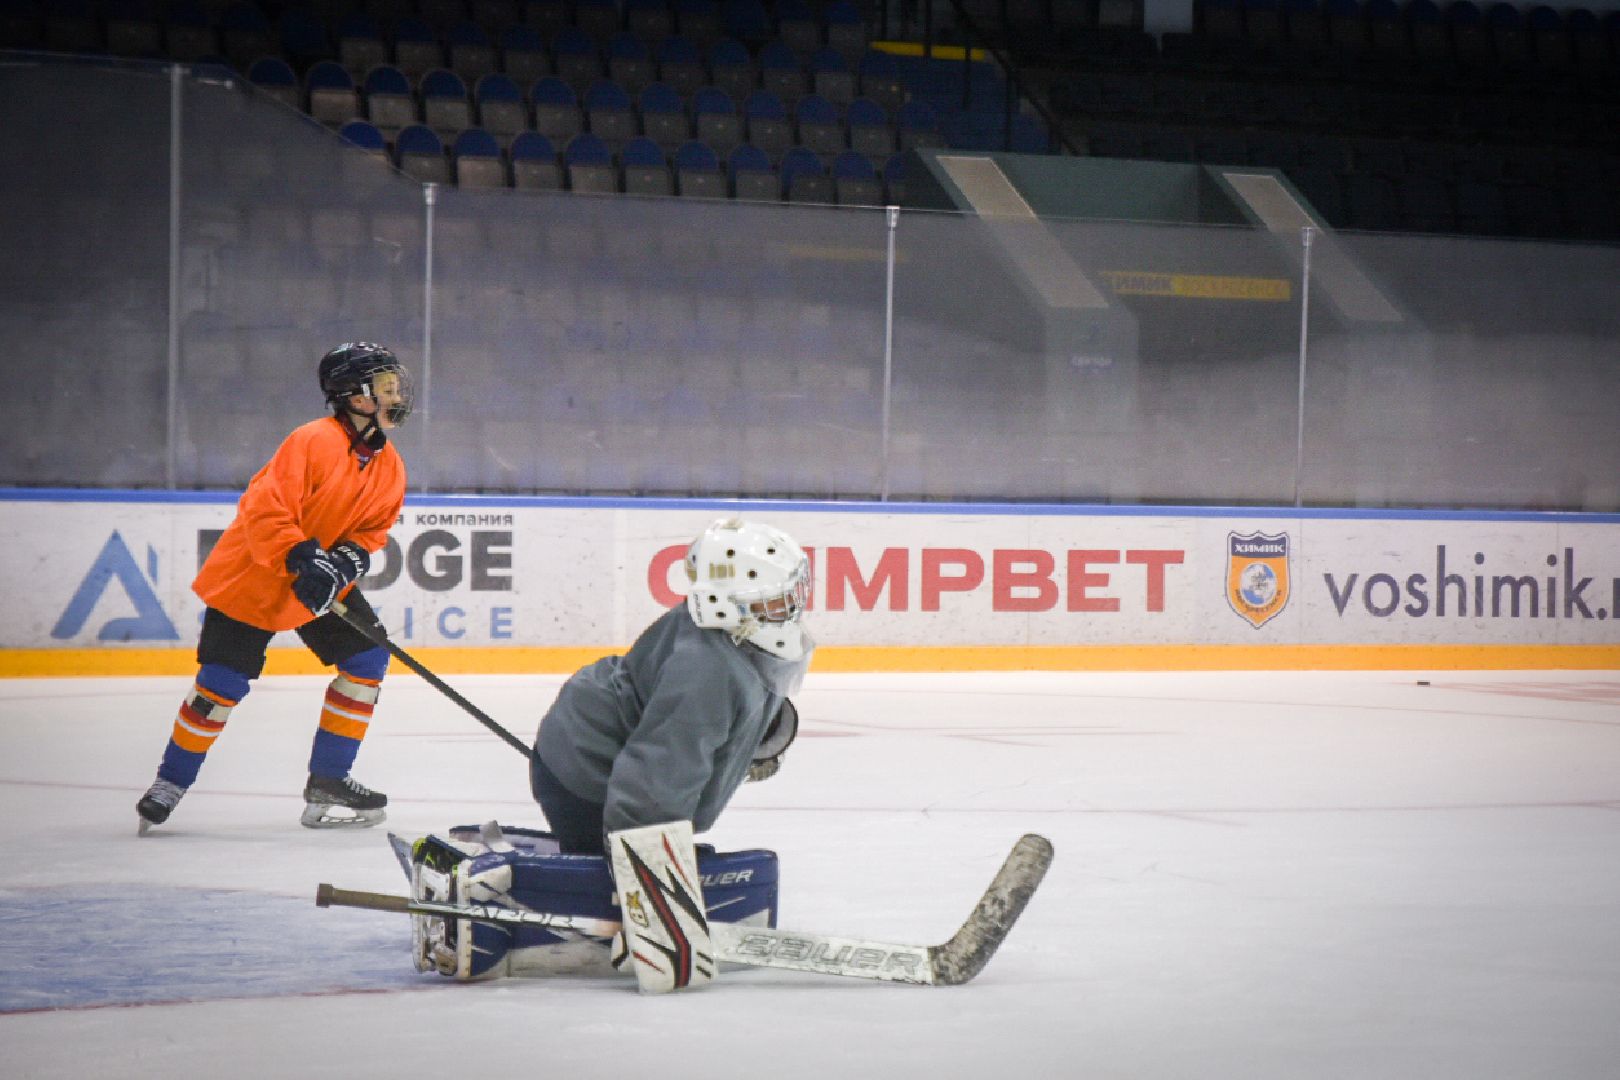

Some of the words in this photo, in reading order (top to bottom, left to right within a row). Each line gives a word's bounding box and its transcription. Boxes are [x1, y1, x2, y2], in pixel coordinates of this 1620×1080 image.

[416, 514, 513, 526] компания
[648, 544, 1185, 612] OIMPBET
[697, 869, 754, 887] UER
[736, 934, 924, 976] BAUER
